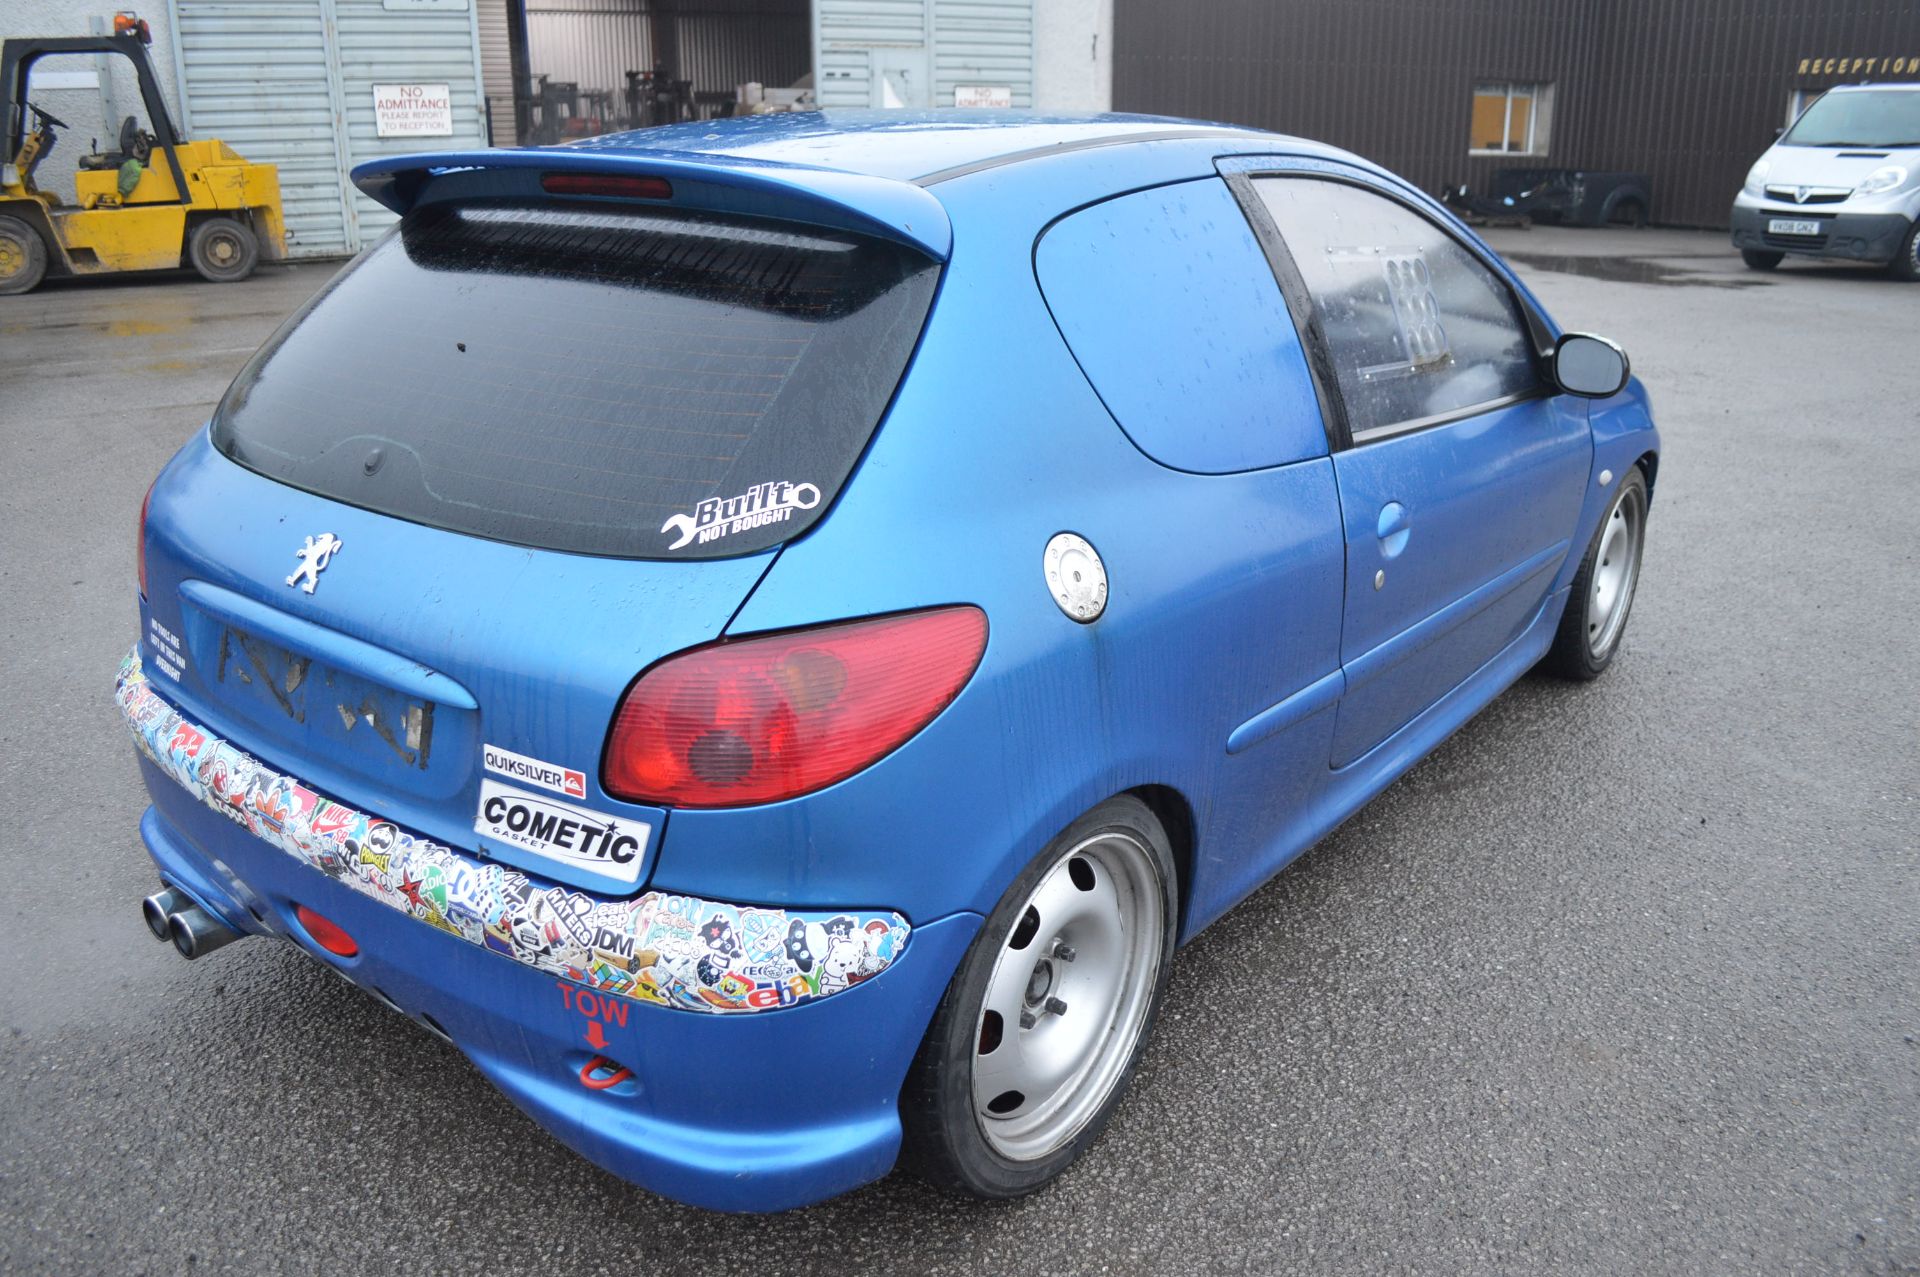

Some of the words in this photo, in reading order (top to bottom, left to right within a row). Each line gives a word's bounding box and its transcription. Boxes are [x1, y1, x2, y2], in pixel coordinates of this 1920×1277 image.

[1798, 57, 1920, 75] RECEPTION
[378, 98, 448, 110] ADMITTANCE
[400, 86, 423, 98] NO
[974, 87, 992, 98] NO
[382, 111, 409, 120] PLEASE
[412, 111, 443, 120] REPORT
[385, 122, 397, 130] TO
[400, 121, 444, 130] RECEPTION
[696, 481, 794, 529] Built
[699, 523, 731, 544] NOT
[732, 507, 793, 533] BOUGHT
[485, 752, 562, 788] QUIKSILVER
[323, 803, 351, 826] NIKE
[332, 829, 349, 845] SB
[484, 796, 639, 864] COMETIC
[492, 826, 548, 850] GASKET
[361, 848, 390, 874] PRINGLES
[547, 888, 591, 947] HATERS
[591, 926, 635, 957] JDM
[557, 981, 629, 1028] TOW
